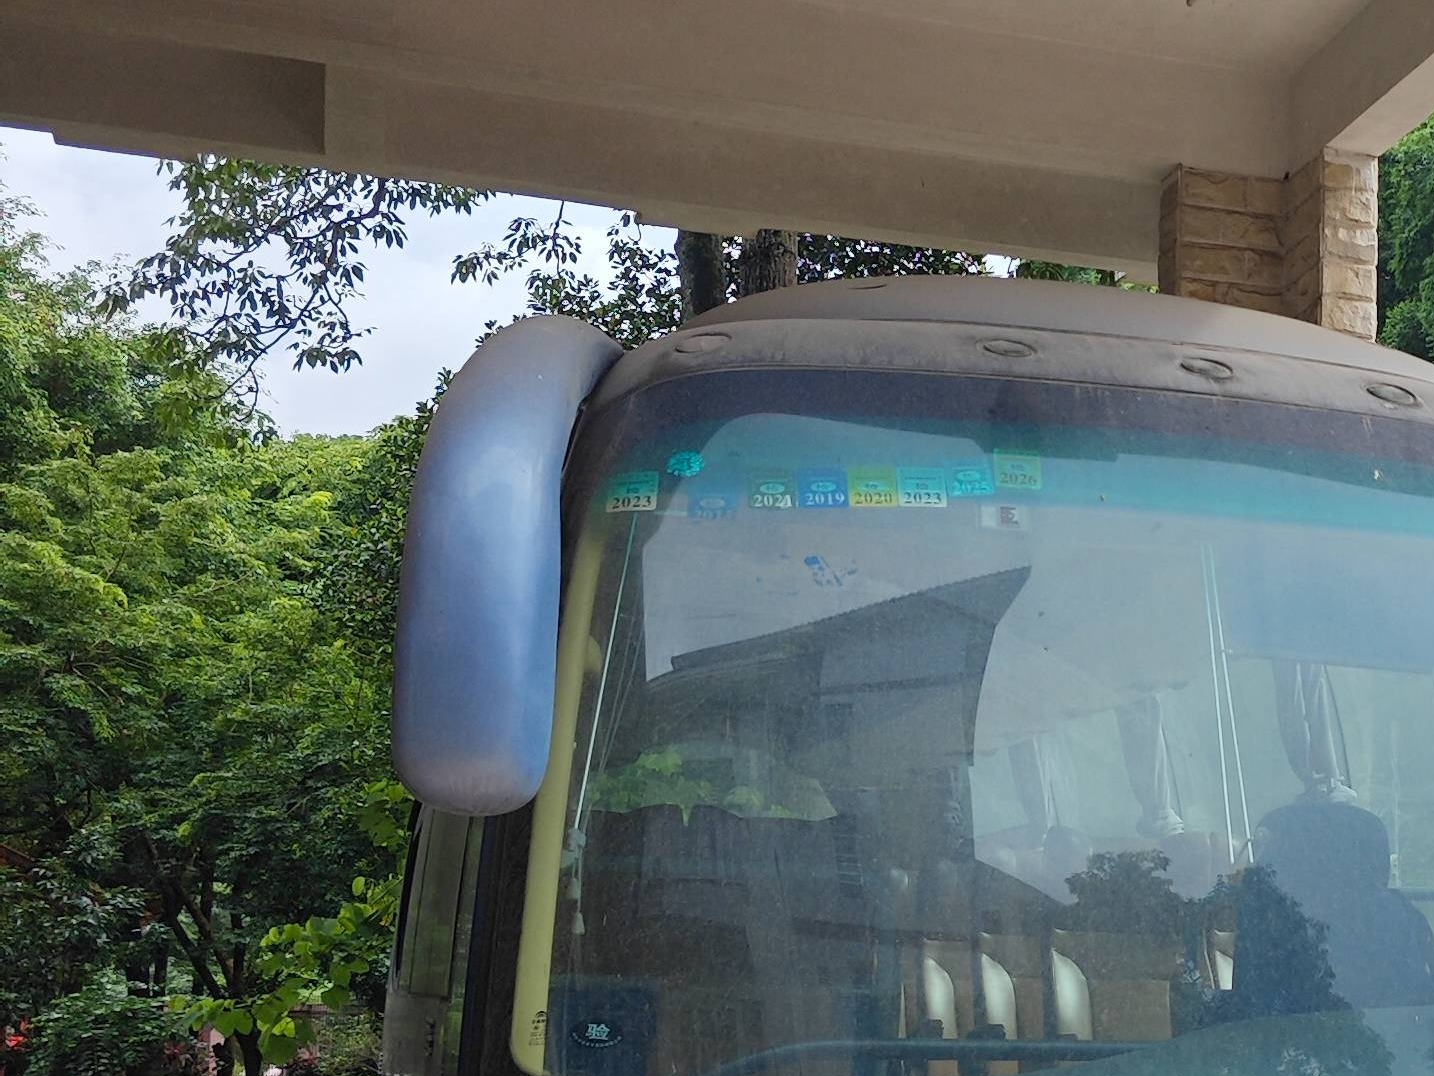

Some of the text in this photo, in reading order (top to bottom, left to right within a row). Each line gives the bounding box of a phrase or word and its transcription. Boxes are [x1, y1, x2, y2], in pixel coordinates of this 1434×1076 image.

[611, 496, 652, 510] 2023
[805, 493, 845, 506] 2019
[854, 491, 893, 505] 2020
[903, 491, 942, 505] 2023
[585, 1023, 611, 1041] 验
